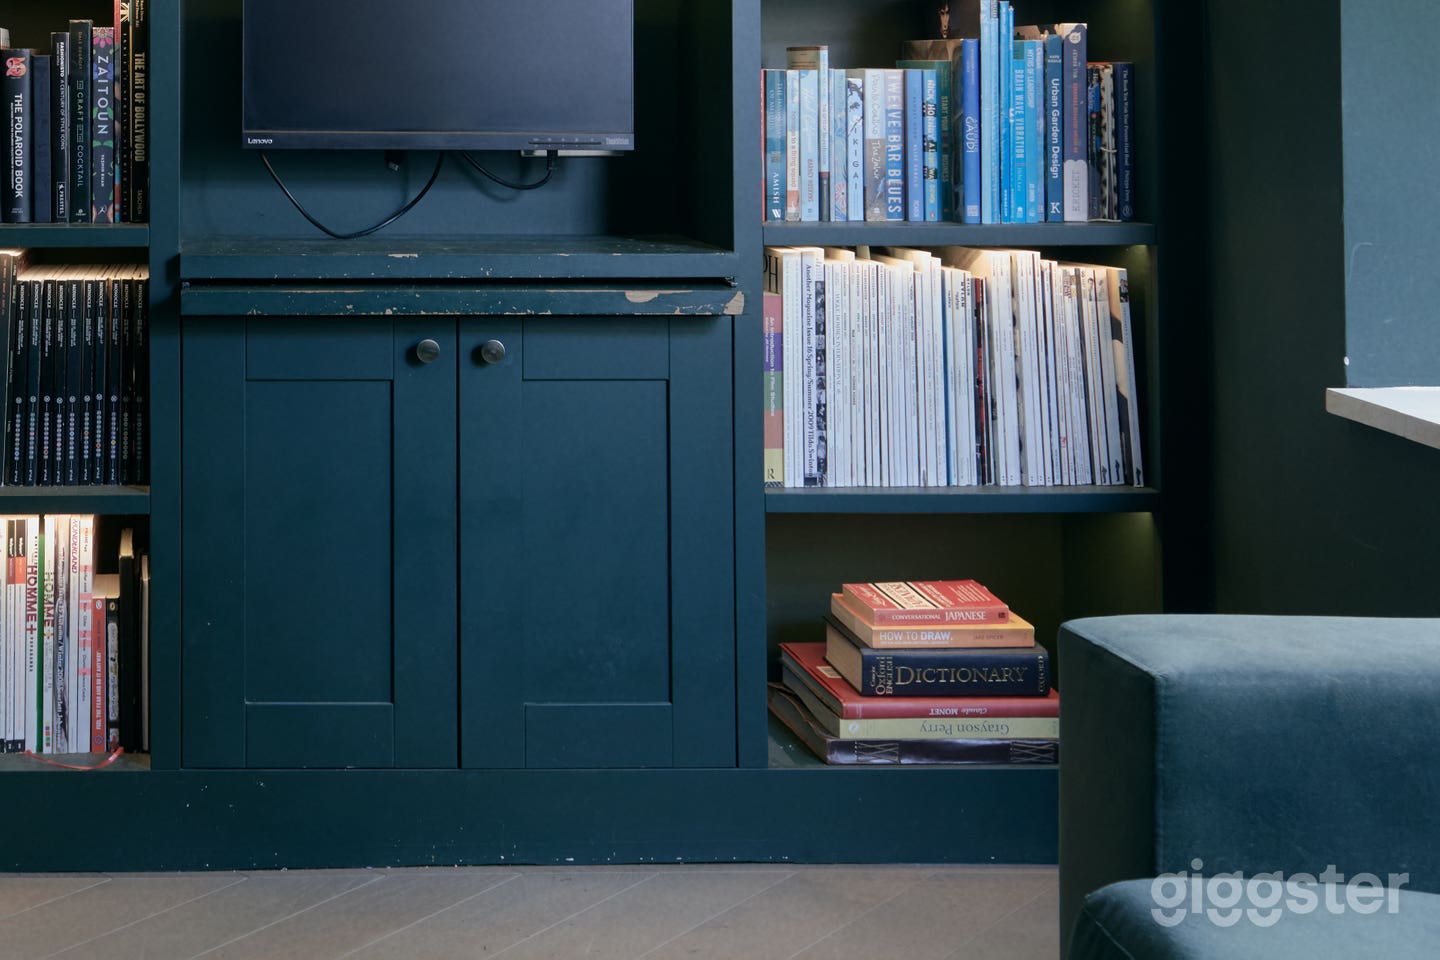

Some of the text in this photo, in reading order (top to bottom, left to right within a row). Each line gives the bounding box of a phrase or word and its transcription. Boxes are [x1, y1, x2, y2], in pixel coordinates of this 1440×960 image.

[134, 52, 145, 71] THE
[97, 55, 109, 135] ZAITOUN
[134, 73, 145, 89] ART
[134, 91, 145, 104] OF
[1014, 69, 1025, 159] BRAIN WAVE VIBRATION
[1050, 78, 1060, 179] Urban Garden Design
[14, 93, 24, 198] THE POLAROID BOOK
[134, 106, 145, 162] BOLLYWOOD
[247, 137, 273, 145] Lenovo
[887, 73, 902, 213] TWELVE BAR BLUES
[77, 145, 85, 188] COCKTAIL
[771, 171, 780, 204] AMISH
[805, 264, 814, 292] Another
[805, 293, 813, 326] Magazine
[807, 345, 813, 354] 16
[805, 353, 814, 410] Spring/Summer
[808, 448, 816, 477] Swinton
[945, 610, 987, 621] JAPANESE
[880, 631, 954, 640] HOW TO DRAW.
[875, 657, 885, 695] Oxford
[895, 666, 1028, 685] DICTIONARY
[929, 706, 988, 716] Claude MONET
[919, 719, 1010, 735] Grayson Perry
